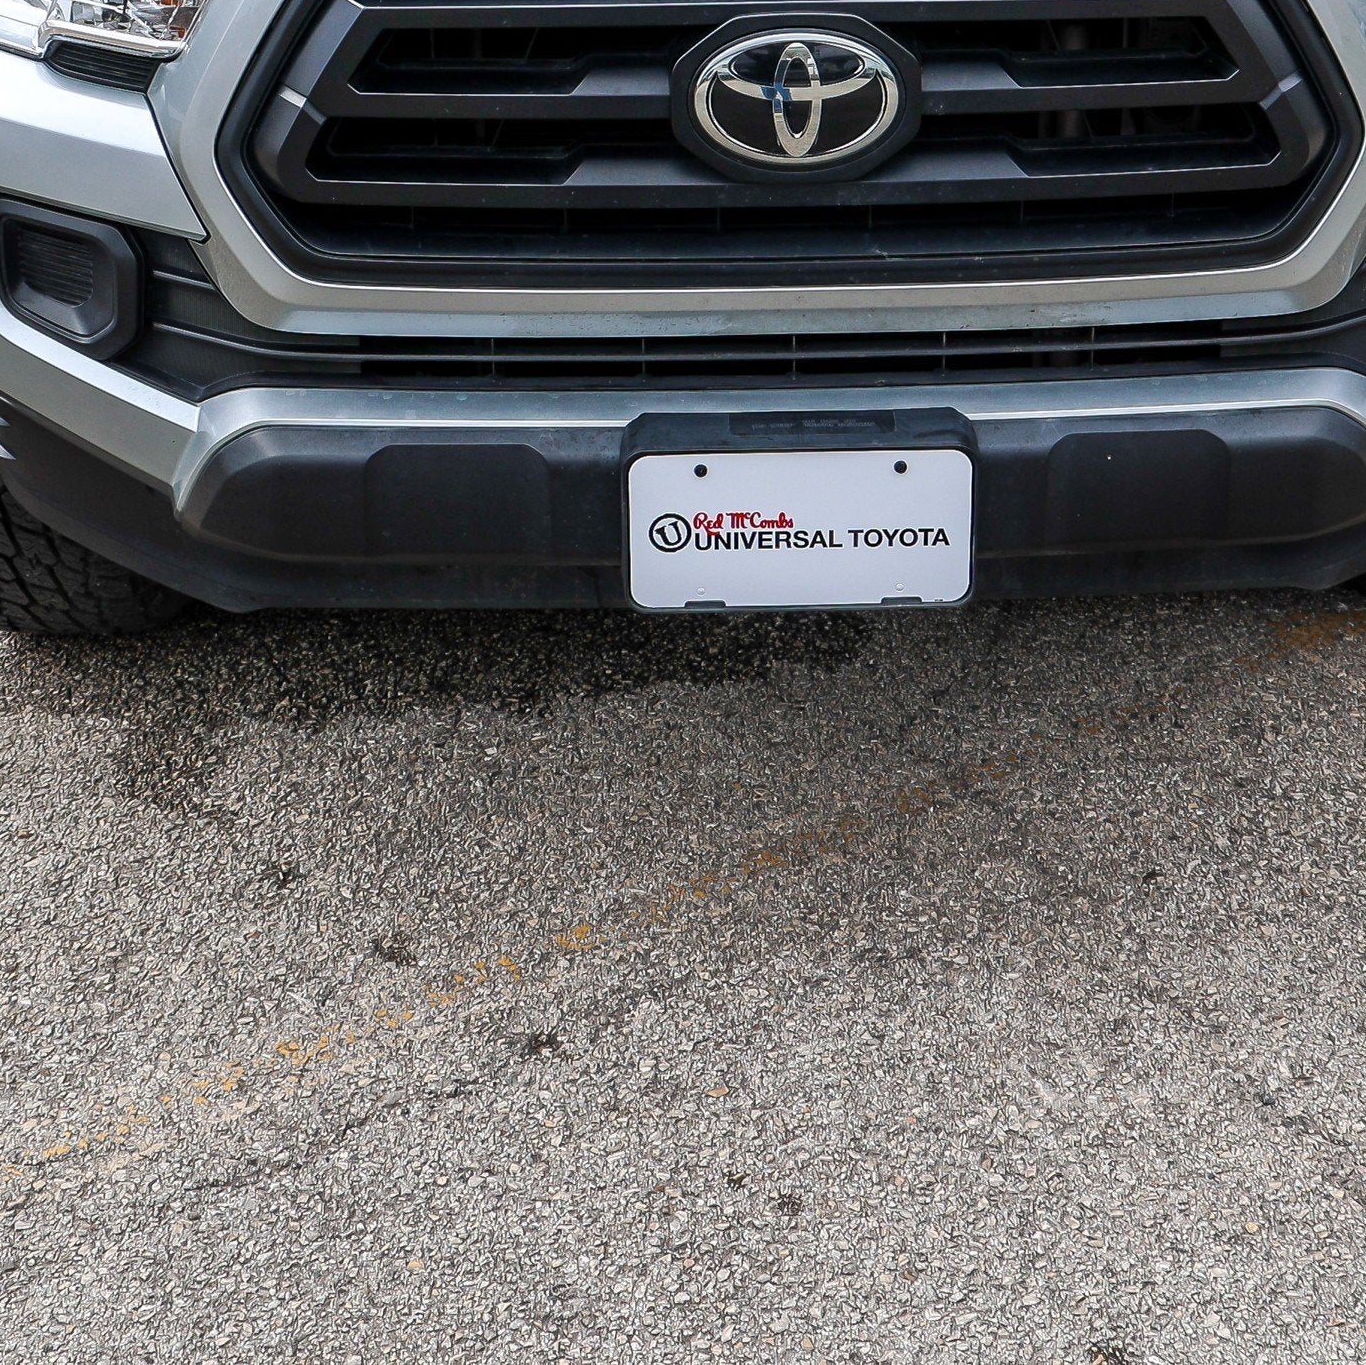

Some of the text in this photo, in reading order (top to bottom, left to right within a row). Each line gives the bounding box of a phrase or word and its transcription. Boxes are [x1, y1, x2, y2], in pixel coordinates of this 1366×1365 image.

[693, 512, 794, 535] Red McCombs
[694, 527, 951, 550] UNIVERSAL TOYOTA
